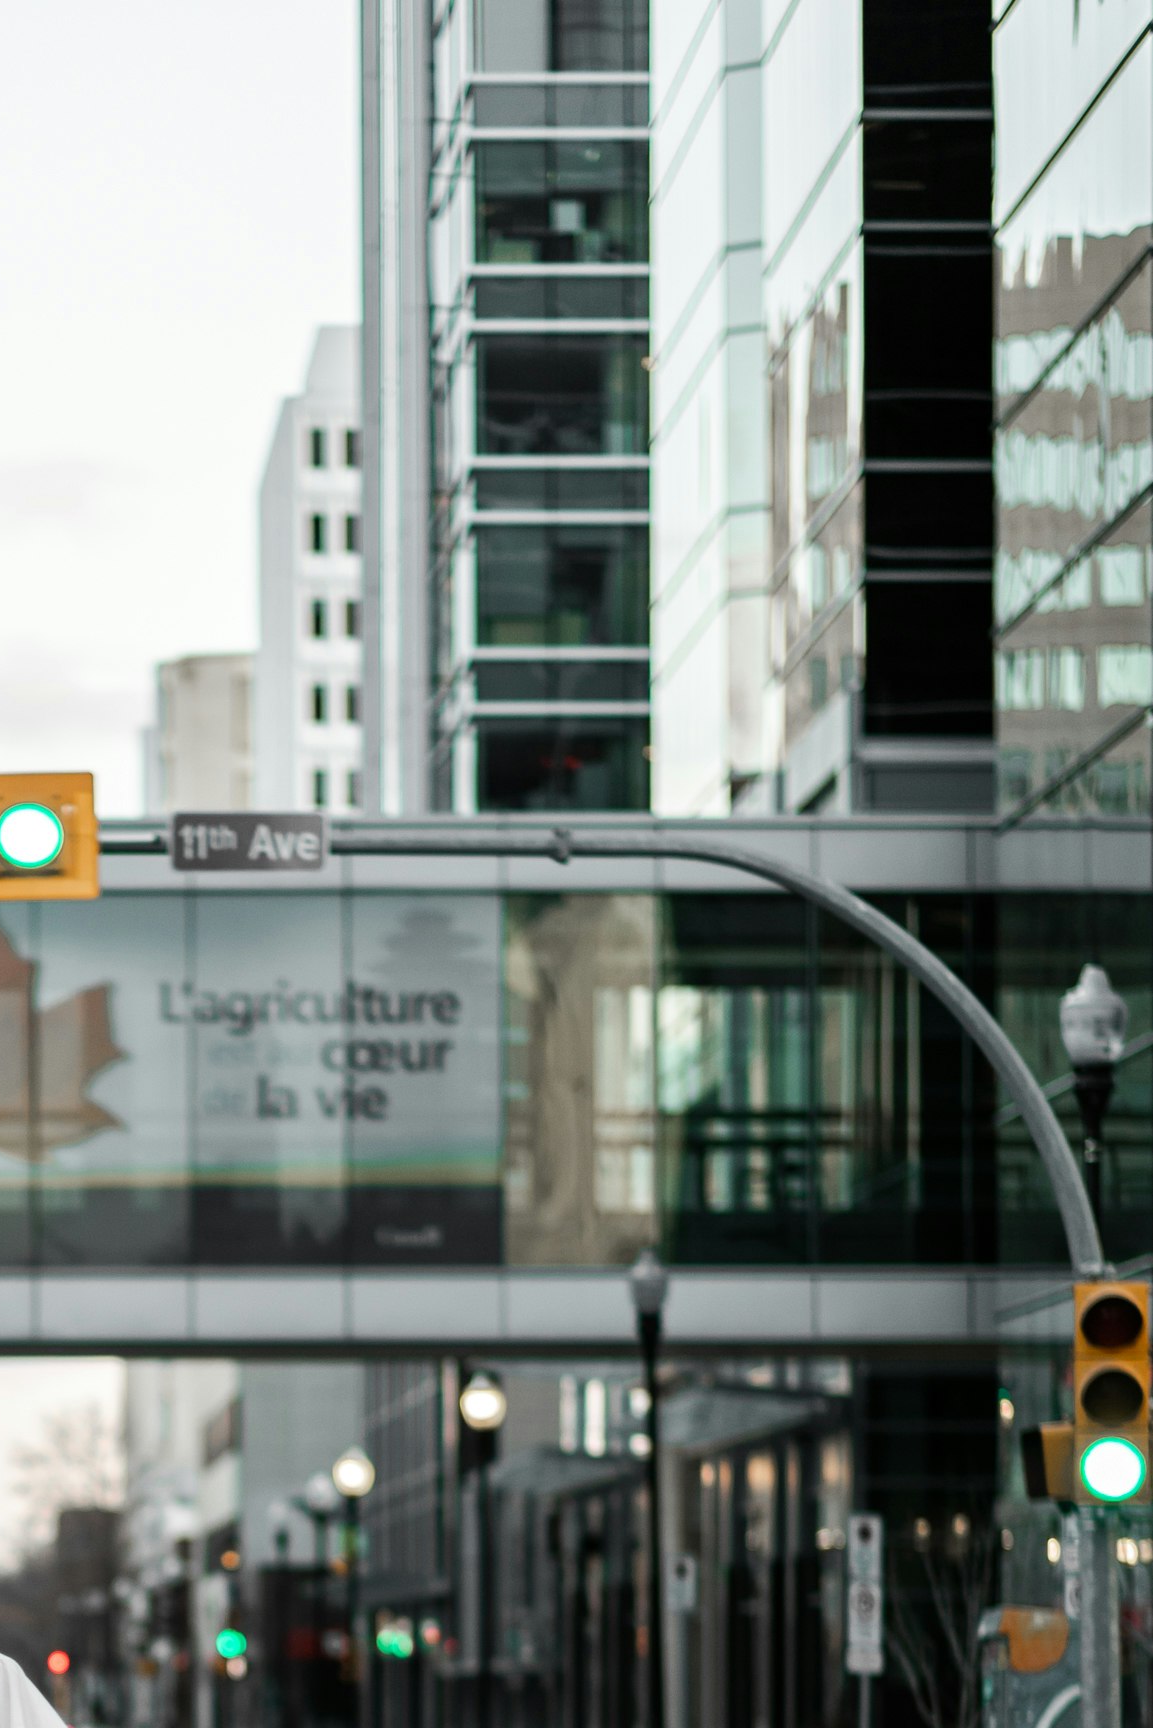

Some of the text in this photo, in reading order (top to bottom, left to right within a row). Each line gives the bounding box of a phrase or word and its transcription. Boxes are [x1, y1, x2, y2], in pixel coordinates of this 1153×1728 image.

[179, 824, 319, 861] 11th Ave
[257, 1074, 298, 1120] la
[315, 1074, 389, 1121] vie
